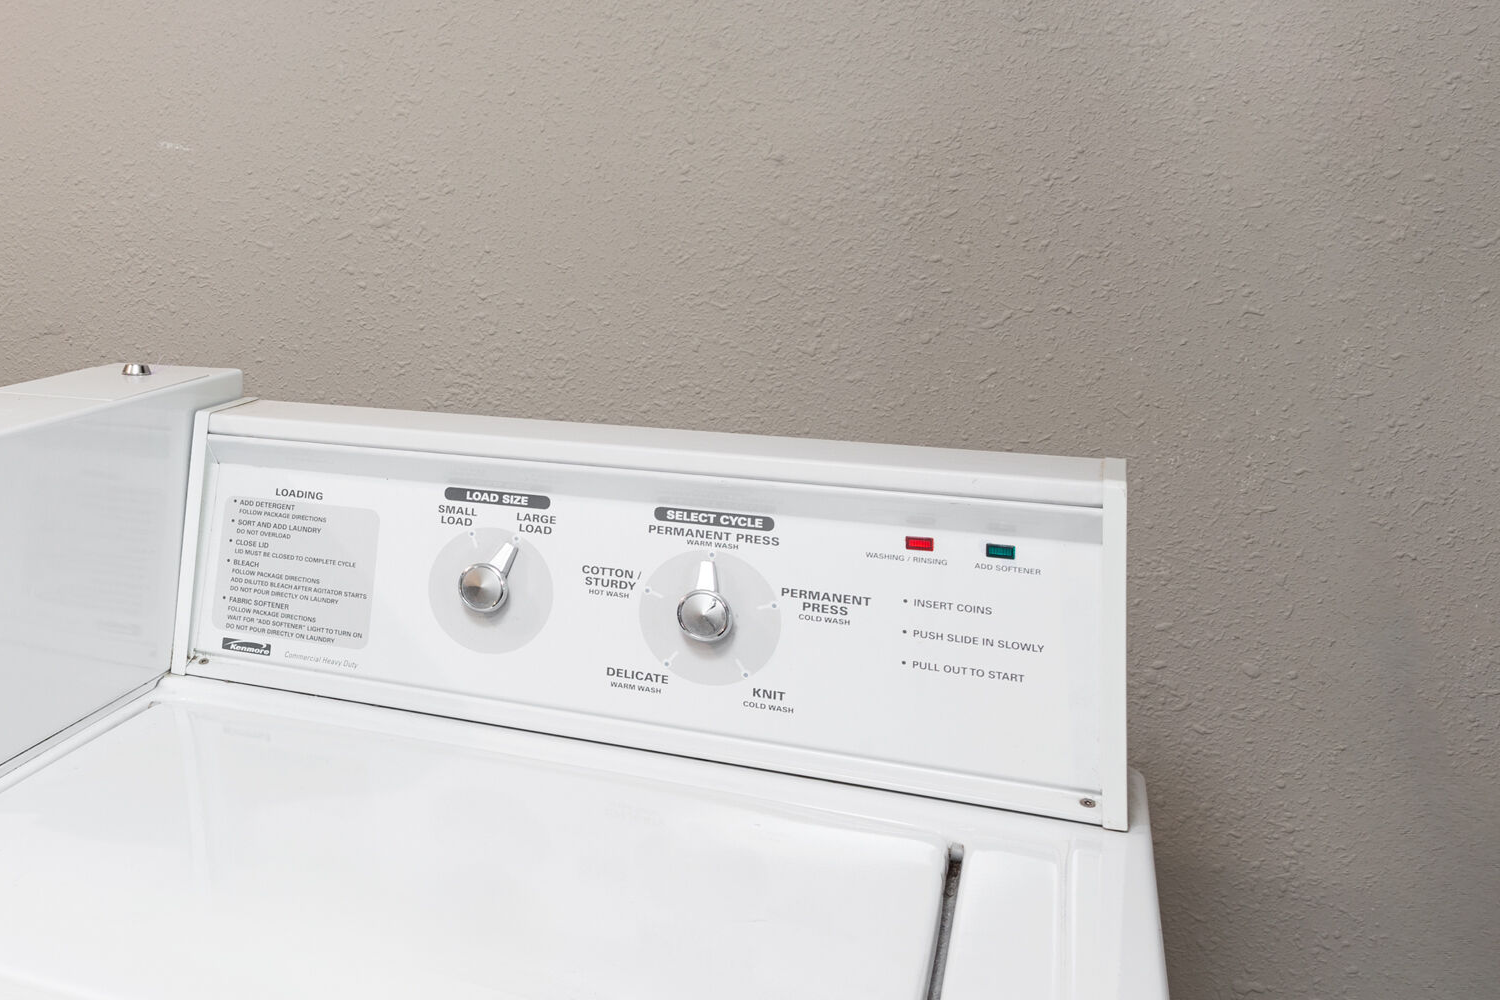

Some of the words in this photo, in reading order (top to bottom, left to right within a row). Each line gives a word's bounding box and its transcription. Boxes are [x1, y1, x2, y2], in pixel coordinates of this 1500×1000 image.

[276, 488, 323, 500] LOADING
[466, 491, 499, 502] LOAD
[502, 494, 528, 505] SIZE
[255, 501, 295, 511] DETERGENT
[438, 505, 477, 516] SMALL
[291, 514, 326, 523] DIRECTIONS
[441, 515, 472, 526] LOAD
[517, 512, 556, 524] LARGE
[666, 510, 716, 523] SELECT
[720, 515, 763, 528] CYCLE
[260, 531, 291, 539] OVERLOAD
[288, 525, 322, 534] LAUNDRY
[519, 524, 552, 535] LOAD
[648, 525, 732, 541] PERMANENT
[736, 533, 779, 546] PRESS
[236, 540, 257, 548] CLOSE
[233, 560, 259, 568] BLEACH
[304, 557, 336, 566] COMPLETE
[866, 552, 905, 561] WASHING
[913, 556, 947, 566] RINSING
[582, 565, 634, 579] COTTON
[996, 565, 1041, 575] SOFTENER
[257, 571, 283, 580] PACKAGE
[284, 575, 320, 584] DIRECTIONS
[585, 576, 636, 590] STURDY
[271, 591, 298, 599] DIRECTLY
[310, 596, 339, 604] LAUNDRY
[313, 588, 343, 596] AGITATOR
[344, 591, 367, 600] STARTS
[781, 588, 871, 606] PERMANENT
[229, 597, 252, 605] FABRIC
[254, 600, 289, 610] SOFTENER
[802, 602, 848, 616] PRESS
[914, 599, 953, 610] INSERT
[956, 604, 992, 615] COINS
[252, 609, 279, 618] PACKAGE
[280, 613, 316, 623] DIRECTIONS
[824, 617, 850, 626] WASH
[272, 621, 306, 630] SOFTENER"
[266, 629, 294, 638] DIRECTLY
[306, 634, 335, 643] LAUNDRY
[913, 630, 944, 640] PUSH
[947, 634, 978, 645] SLIDE
[982, 638, 994, 647] IN
[998, 640, 1044, 653] SLOWLY
[230, 643, 270, 656] Kenmore
[284, 651, 322, 663] Commercial
[322, 657, 342, 666] Heavy
[343, 660, 358, 669] Duty
[606, 667, 668, 684] DELICATE
[912, 660, 940, 672] PULL
[943, 665, 968, 675] OUT
[970, 668, 985, 678] TO
[988, 670, 1024, 683] START
[610, 681, 636, 690] WARM
[637, 685, 661, 694] WASH
[753, 688, 786, 700] KNIT
[743, 701, 766, 710] COLD
[768, 705, 794, 714] WASH
